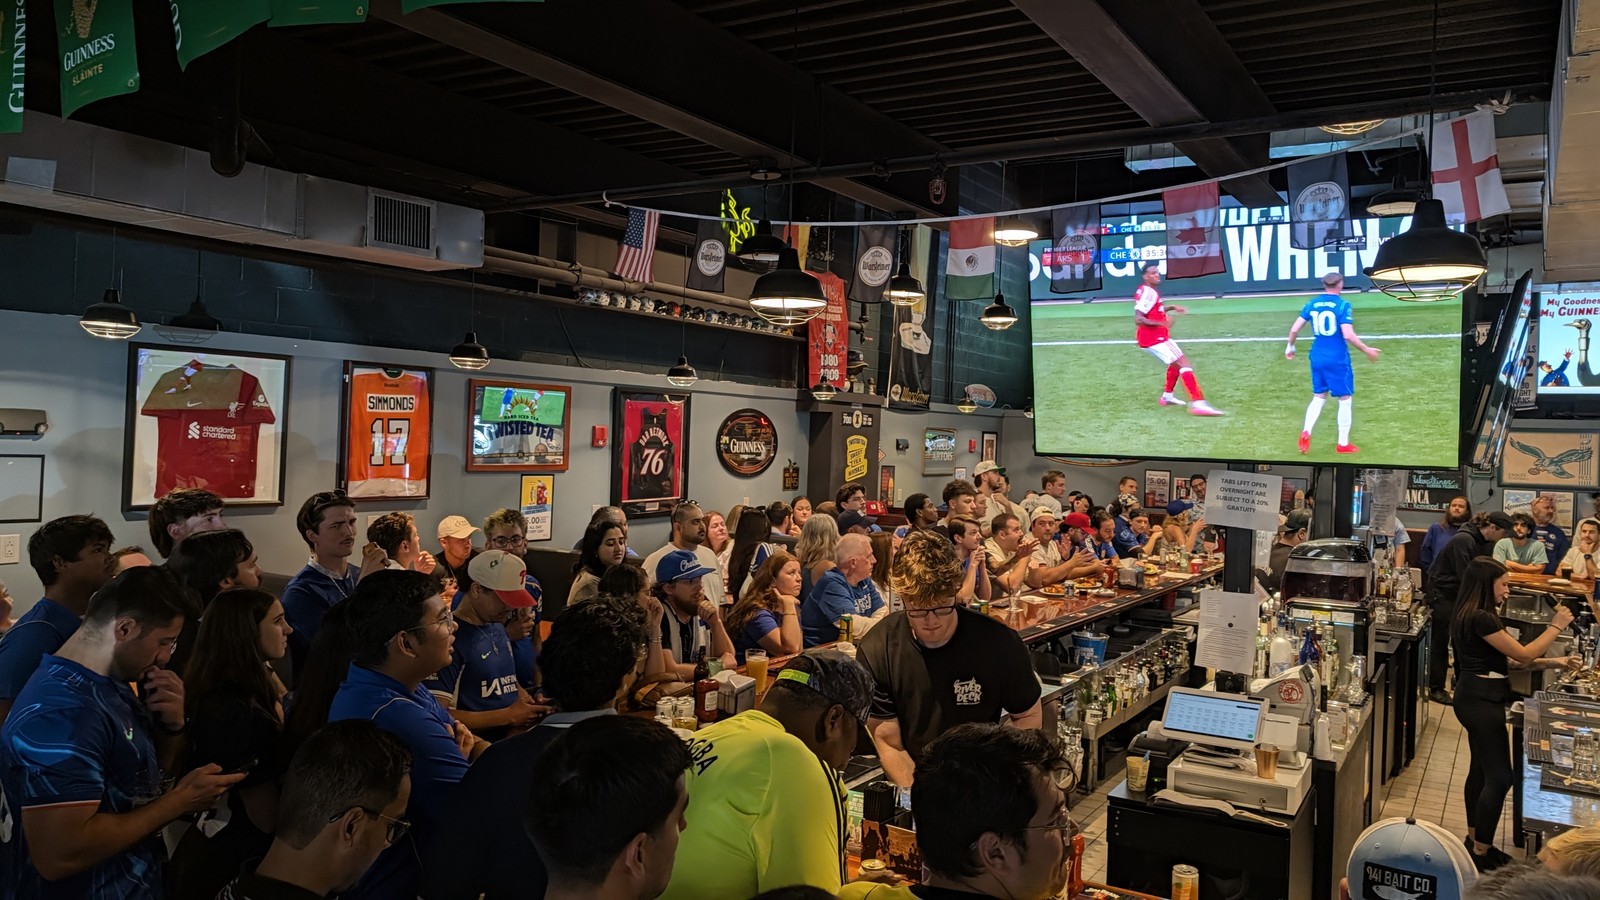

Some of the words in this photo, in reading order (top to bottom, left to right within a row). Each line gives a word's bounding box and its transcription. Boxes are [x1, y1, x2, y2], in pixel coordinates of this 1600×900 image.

[64, 33, 115, 71] GUINNESS
[1110, 251, 1127, 259] CHE
[862, 260, 891, 272] Warsteiner
[1546, 298, 1560, 307] My
[1540, 308, 1555, 318] My
[1558, 306, 1600, 317] GUINNE
[1310, 310, 1337, 336] 10
[820, 353, 839, 367] 1980
[368, 396, 414, 411] SIMMONDS
[202, 425, 235, 434] standard
[489, 420, 535, 440] WISTED
[536, 422, 555, 441] TEA
[202, 432, 236, 440] chartered
[370, 418, 410, 466] 17
[730, 438, 766, 454] GUINNESS
[640, 449, 666, 475] 76
[1219, 487, 1254, 495] OVERNIGHT
[1216, 495, 1241, 503] SUBJECT
[1226, 504, 1256, 513] GRATUITY
[956, 691, 982, 703] DECK
[1366, 865, 1382, 883] 941
[1384, 870, 1410, 888] BAIT
[1413, 877, 1433, 894] CO.
